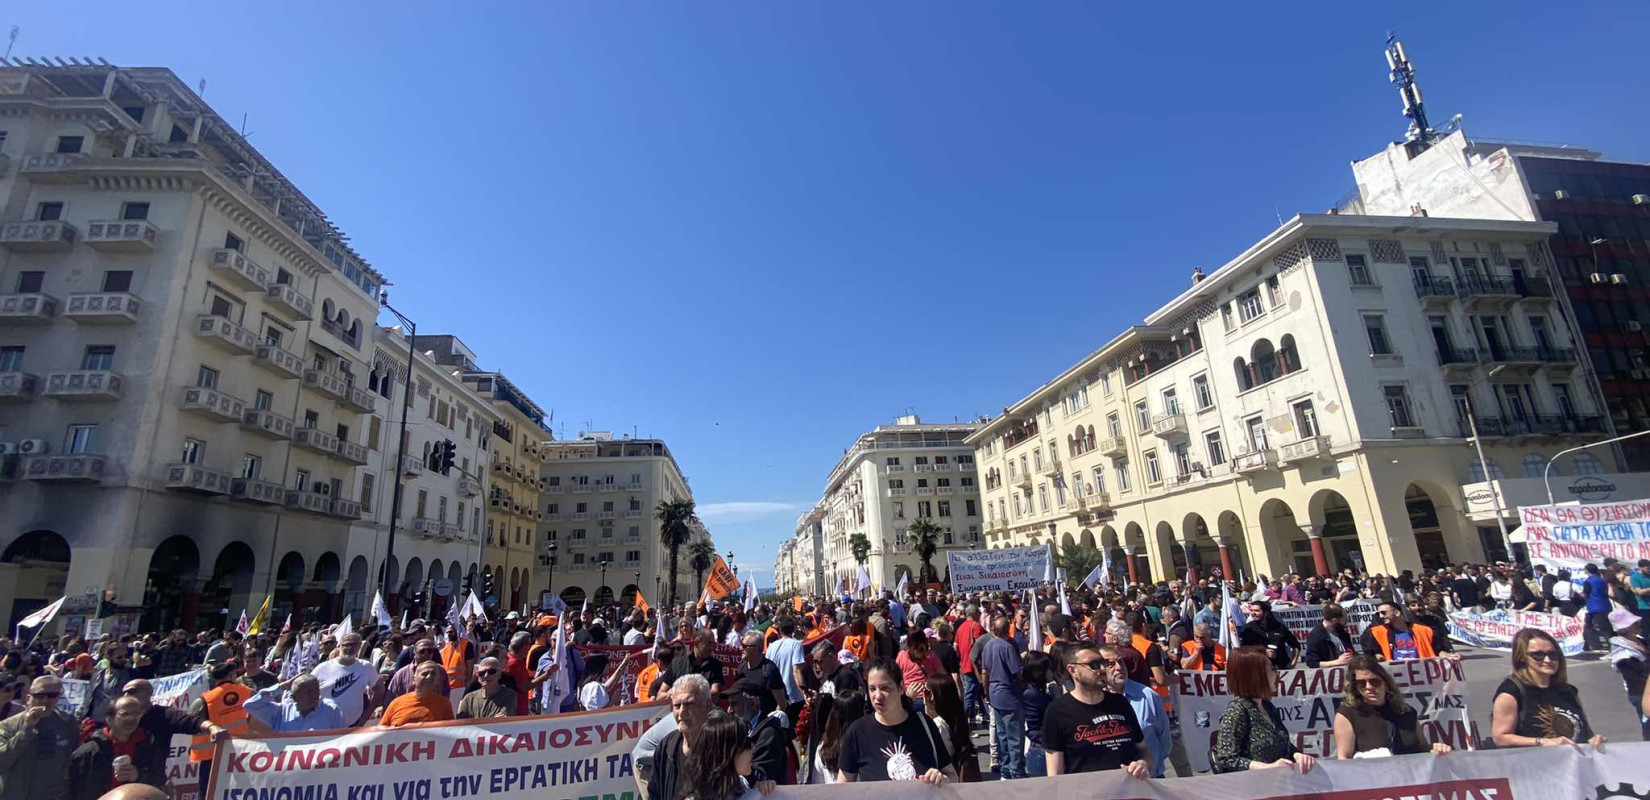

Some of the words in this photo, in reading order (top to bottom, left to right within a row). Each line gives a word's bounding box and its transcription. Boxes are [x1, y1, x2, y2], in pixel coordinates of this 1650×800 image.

[1556, 507, 1577, 522] ΘΑ
[335, 672, 355, 689] NIKE
[227, 740, 436, 773] ΚΟΙΝΩΝΙΚΗ
[349, 783, 385, 800] και
[393, 779, 431, 800] για
[440, 774, 483, 799] την
[489, 757, 598, 794] ΕΡΓΑΤΙΚΗ
